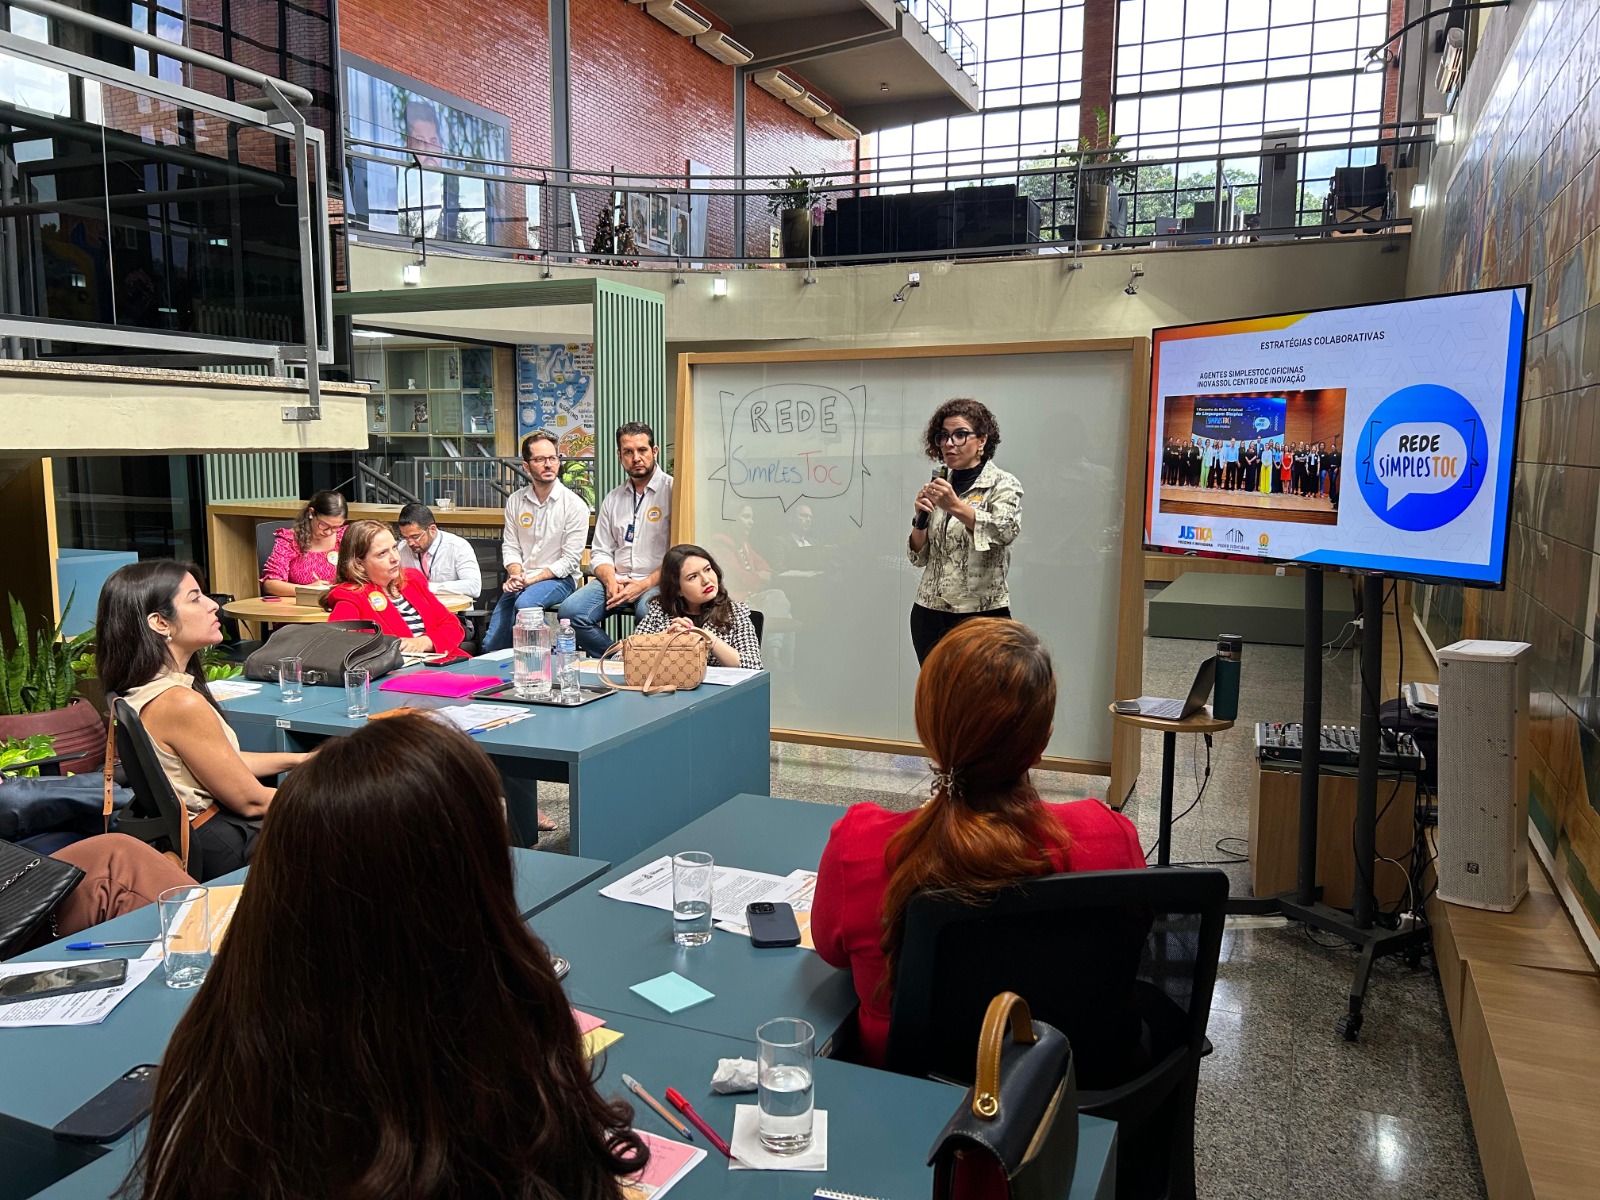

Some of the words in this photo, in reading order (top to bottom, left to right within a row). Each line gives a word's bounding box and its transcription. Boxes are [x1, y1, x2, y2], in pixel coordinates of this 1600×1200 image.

[1260, 337, 1312, 350] ESTRATÉGIAS
[1314, 331, 1385, 346] COLABORATIVAS
[1197, 378, 1231, 388] INOVASSOL
[1232, 377, 1259, 386] CENTRO
[1260, 377, 1268, 385] DE
[1269, 374, 1306, 386] INOVAÇÃO
[1199, 370, 1228, 380] AGENTES
[1228, 366, 1304, 378] SIMPLESTOC/OFICINAS
[750, 396, 838, 433] REDE
[1398, 434, 1441, 453] REDE
[1178, 525, 1213, 542] JUSTIÇA
